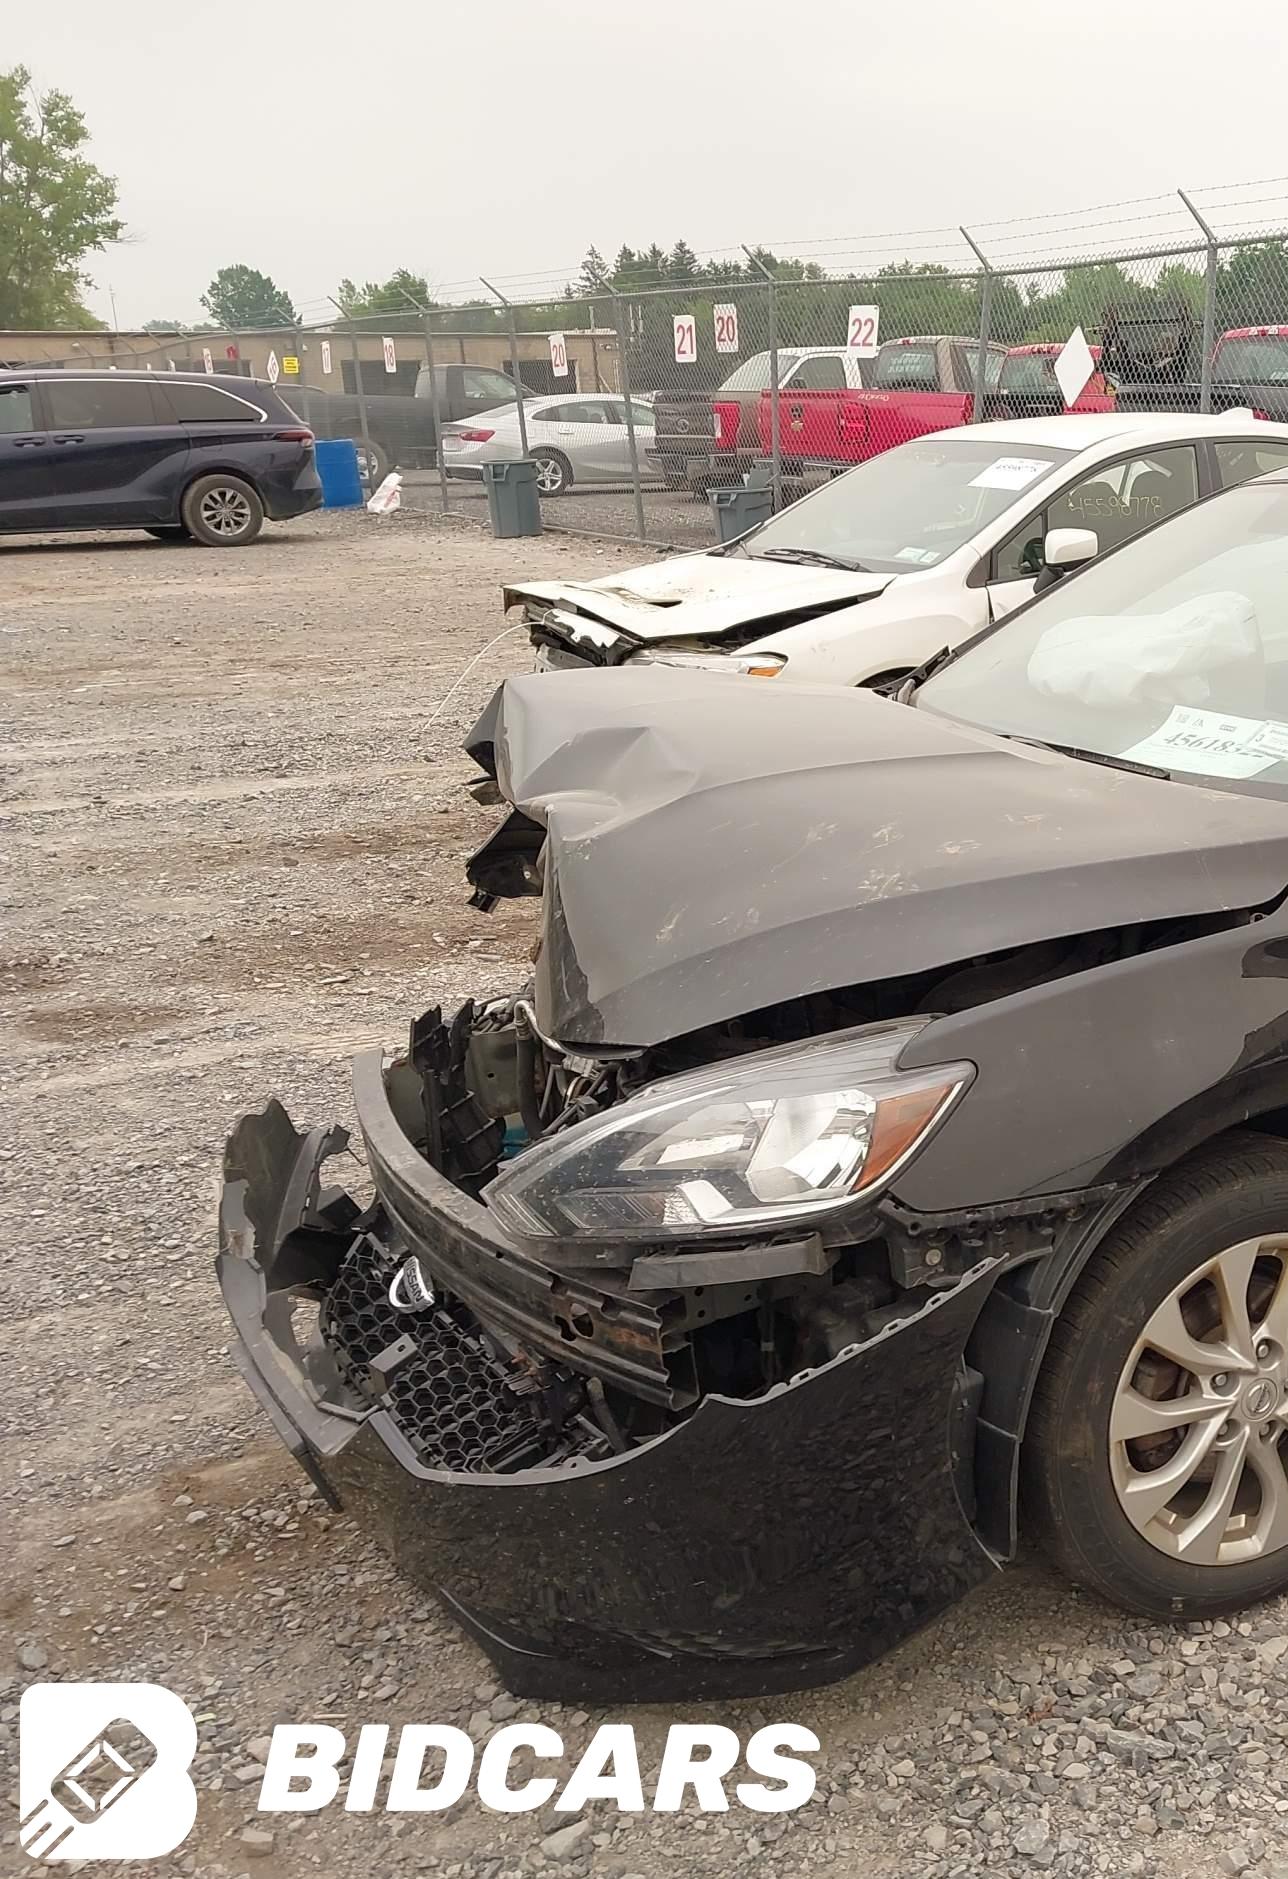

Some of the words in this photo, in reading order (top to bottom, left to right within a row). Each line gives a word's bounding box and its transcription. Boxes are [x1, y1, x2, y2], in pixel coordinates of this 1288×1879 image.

[676, 324, 694, 355] 21
[716, 316, 736, 342] 20
[850, 318, 875, 347] 22
[384, 344, 395, 367] 18
[552, 343, 566, 368] 20
[1068, 495, 1161, 518] 45598778
[1163, 731, 1264, 758] 456185
